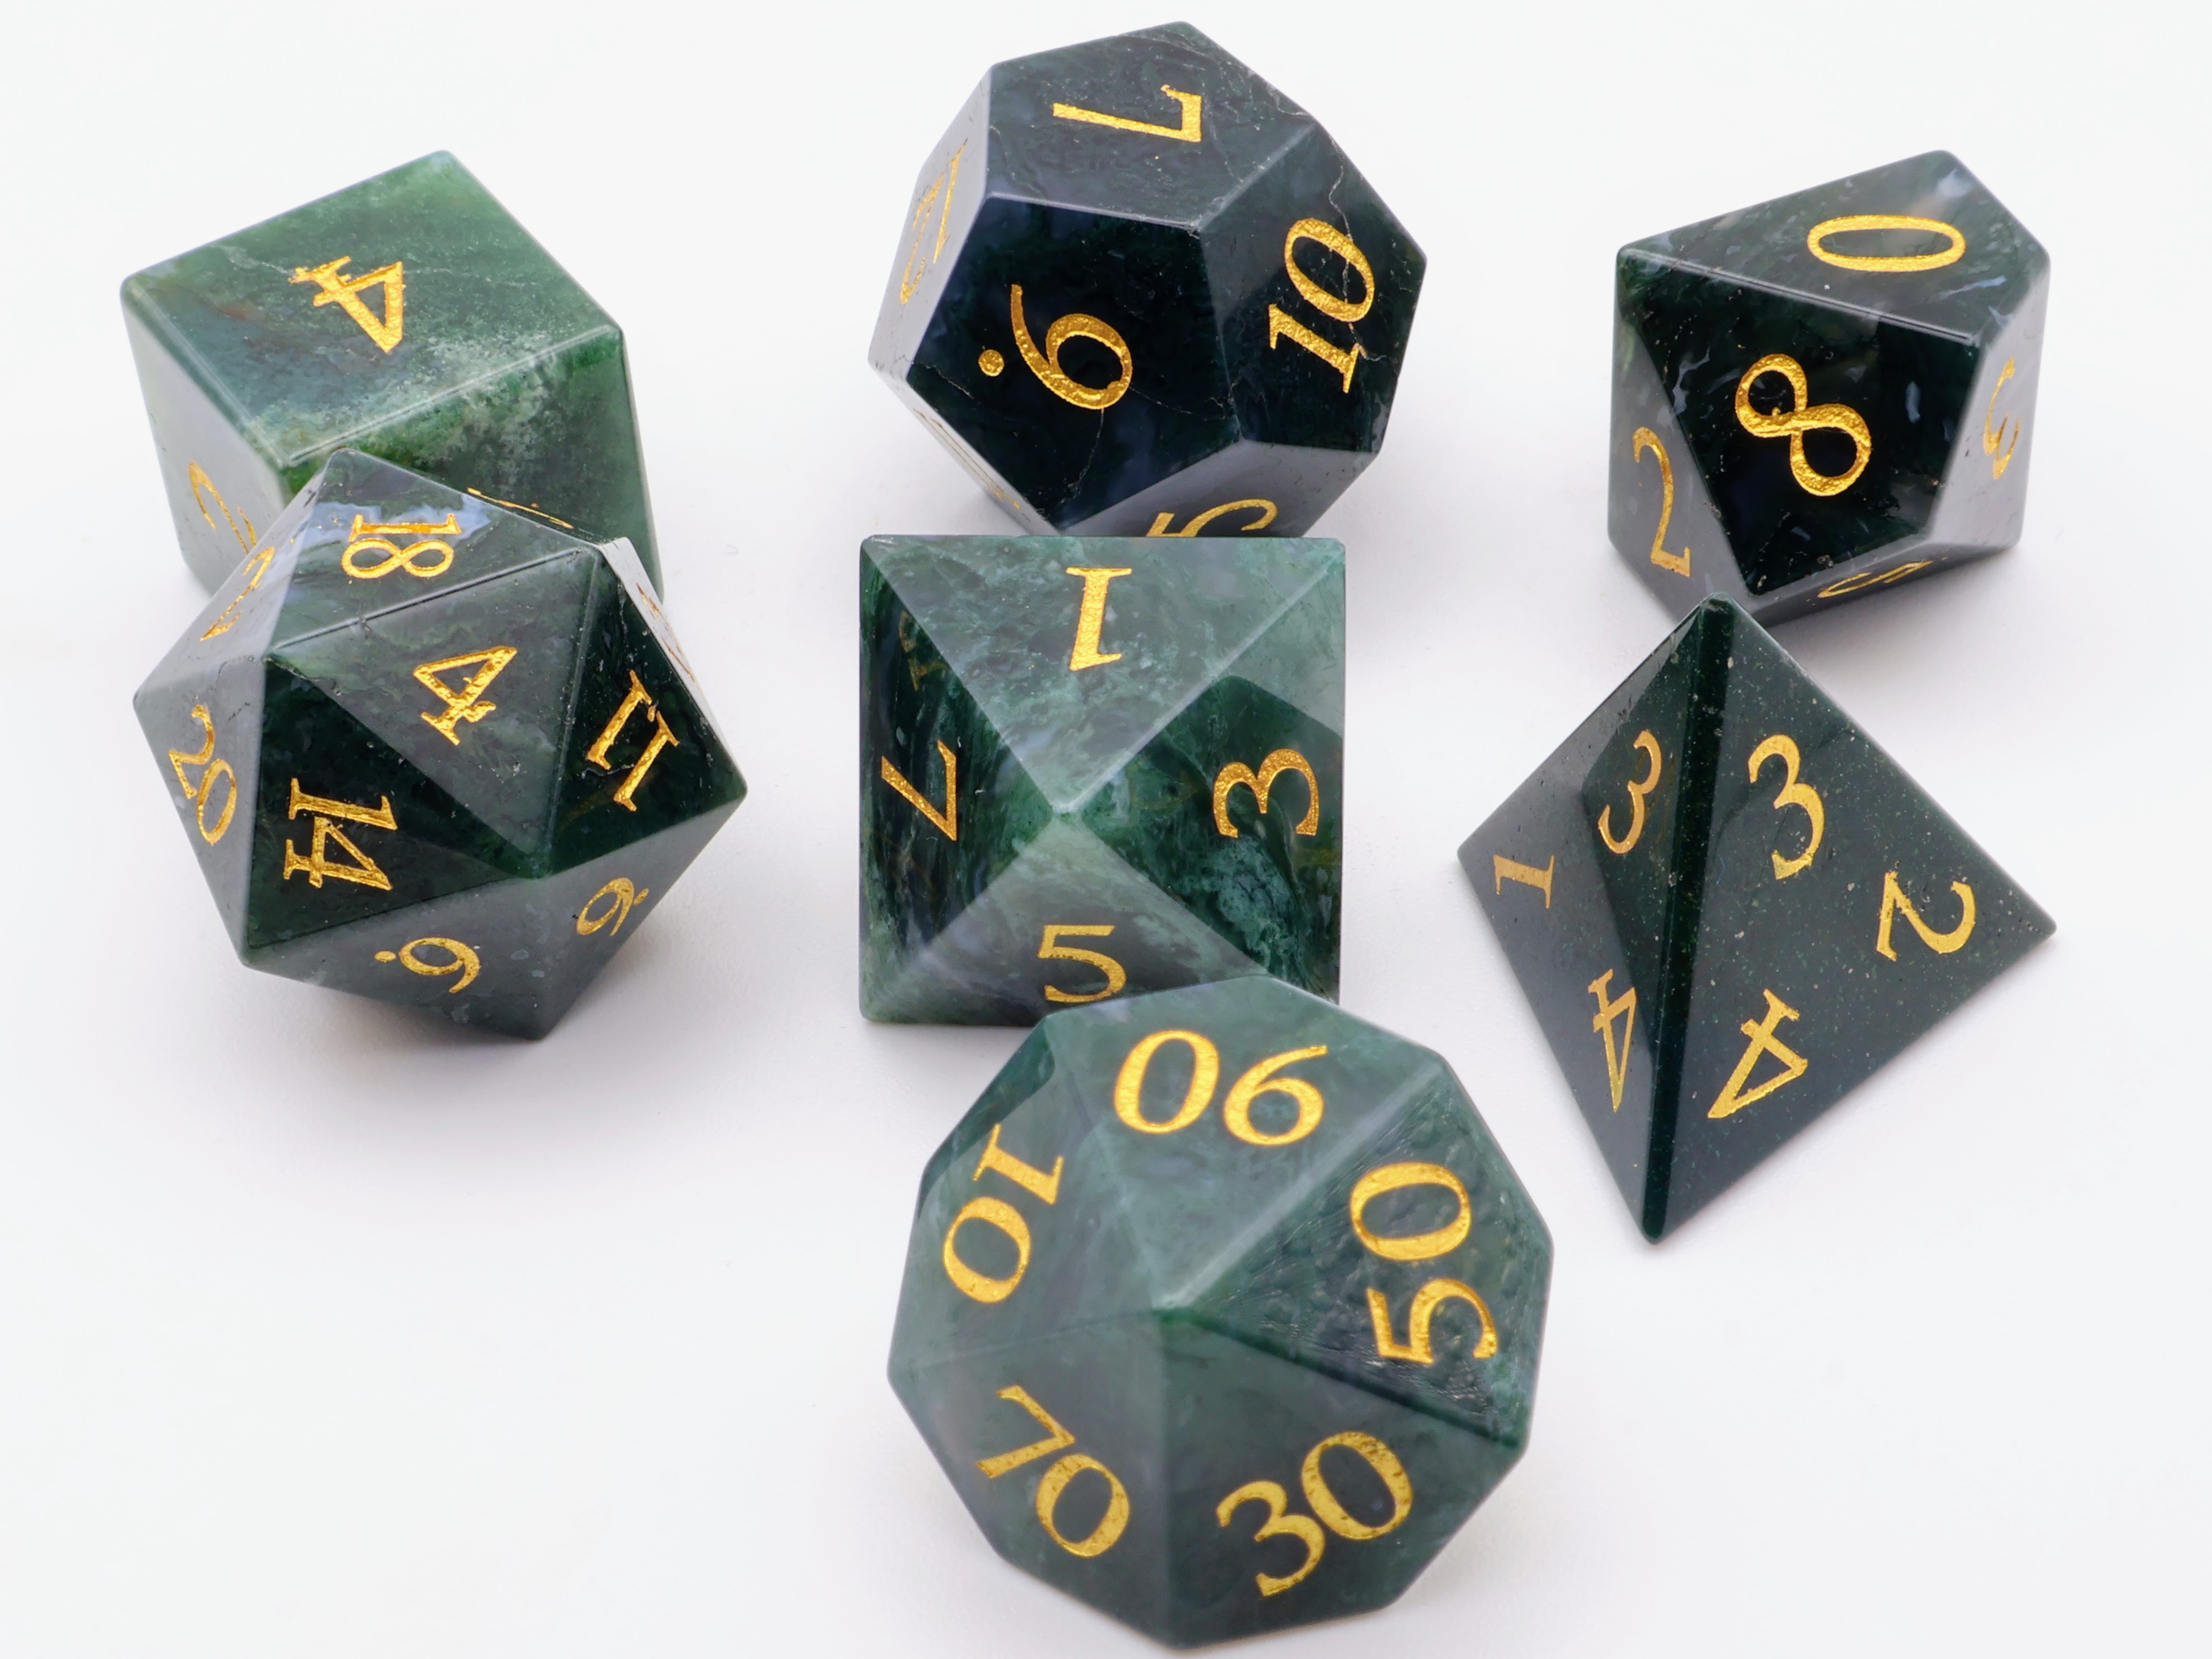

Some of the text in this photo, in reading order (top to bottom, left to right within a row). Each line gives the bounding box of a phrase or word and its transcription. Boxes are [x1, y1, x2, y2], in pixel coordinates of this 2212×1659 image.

[1052, 85, 1203, 142] 7
[1807, 214, 1966, 272] 0
[290, 256, 404, 353] 4
[1268, 218, 1375, 394] 10
[1735, 354, 1872, 496] 8
[341, 515, 462, 578] 18
[1633, 427, 1691, 577] 2
[1066, 567, 1131, 671] 1
[413, 645, 517, 745] 4
[168, 703, 237, 846] 20
[881, 740, 957, 841] 7
[1213, 748, 1320, 838] 3
[1598, 729, 1663, 855] 3
[1747, 733, 1826, 880] 3
[283, 778, 398, 891] 14
[1493, 855, 1555, 910] 1
[1037, 924, 1127, 1004] 5
[1876, 871, 1977, 961] 2
[1588, 969, 1637, 1113] 4
[1707, 988, 1809, 1119] 4
[942, 1125, 1065, 1303] 10
[1349, 1162, 1498, 1365] 50
[977, 1385, 1131, 1559] 70
[1215, 1431, 1414, 1598] 30
